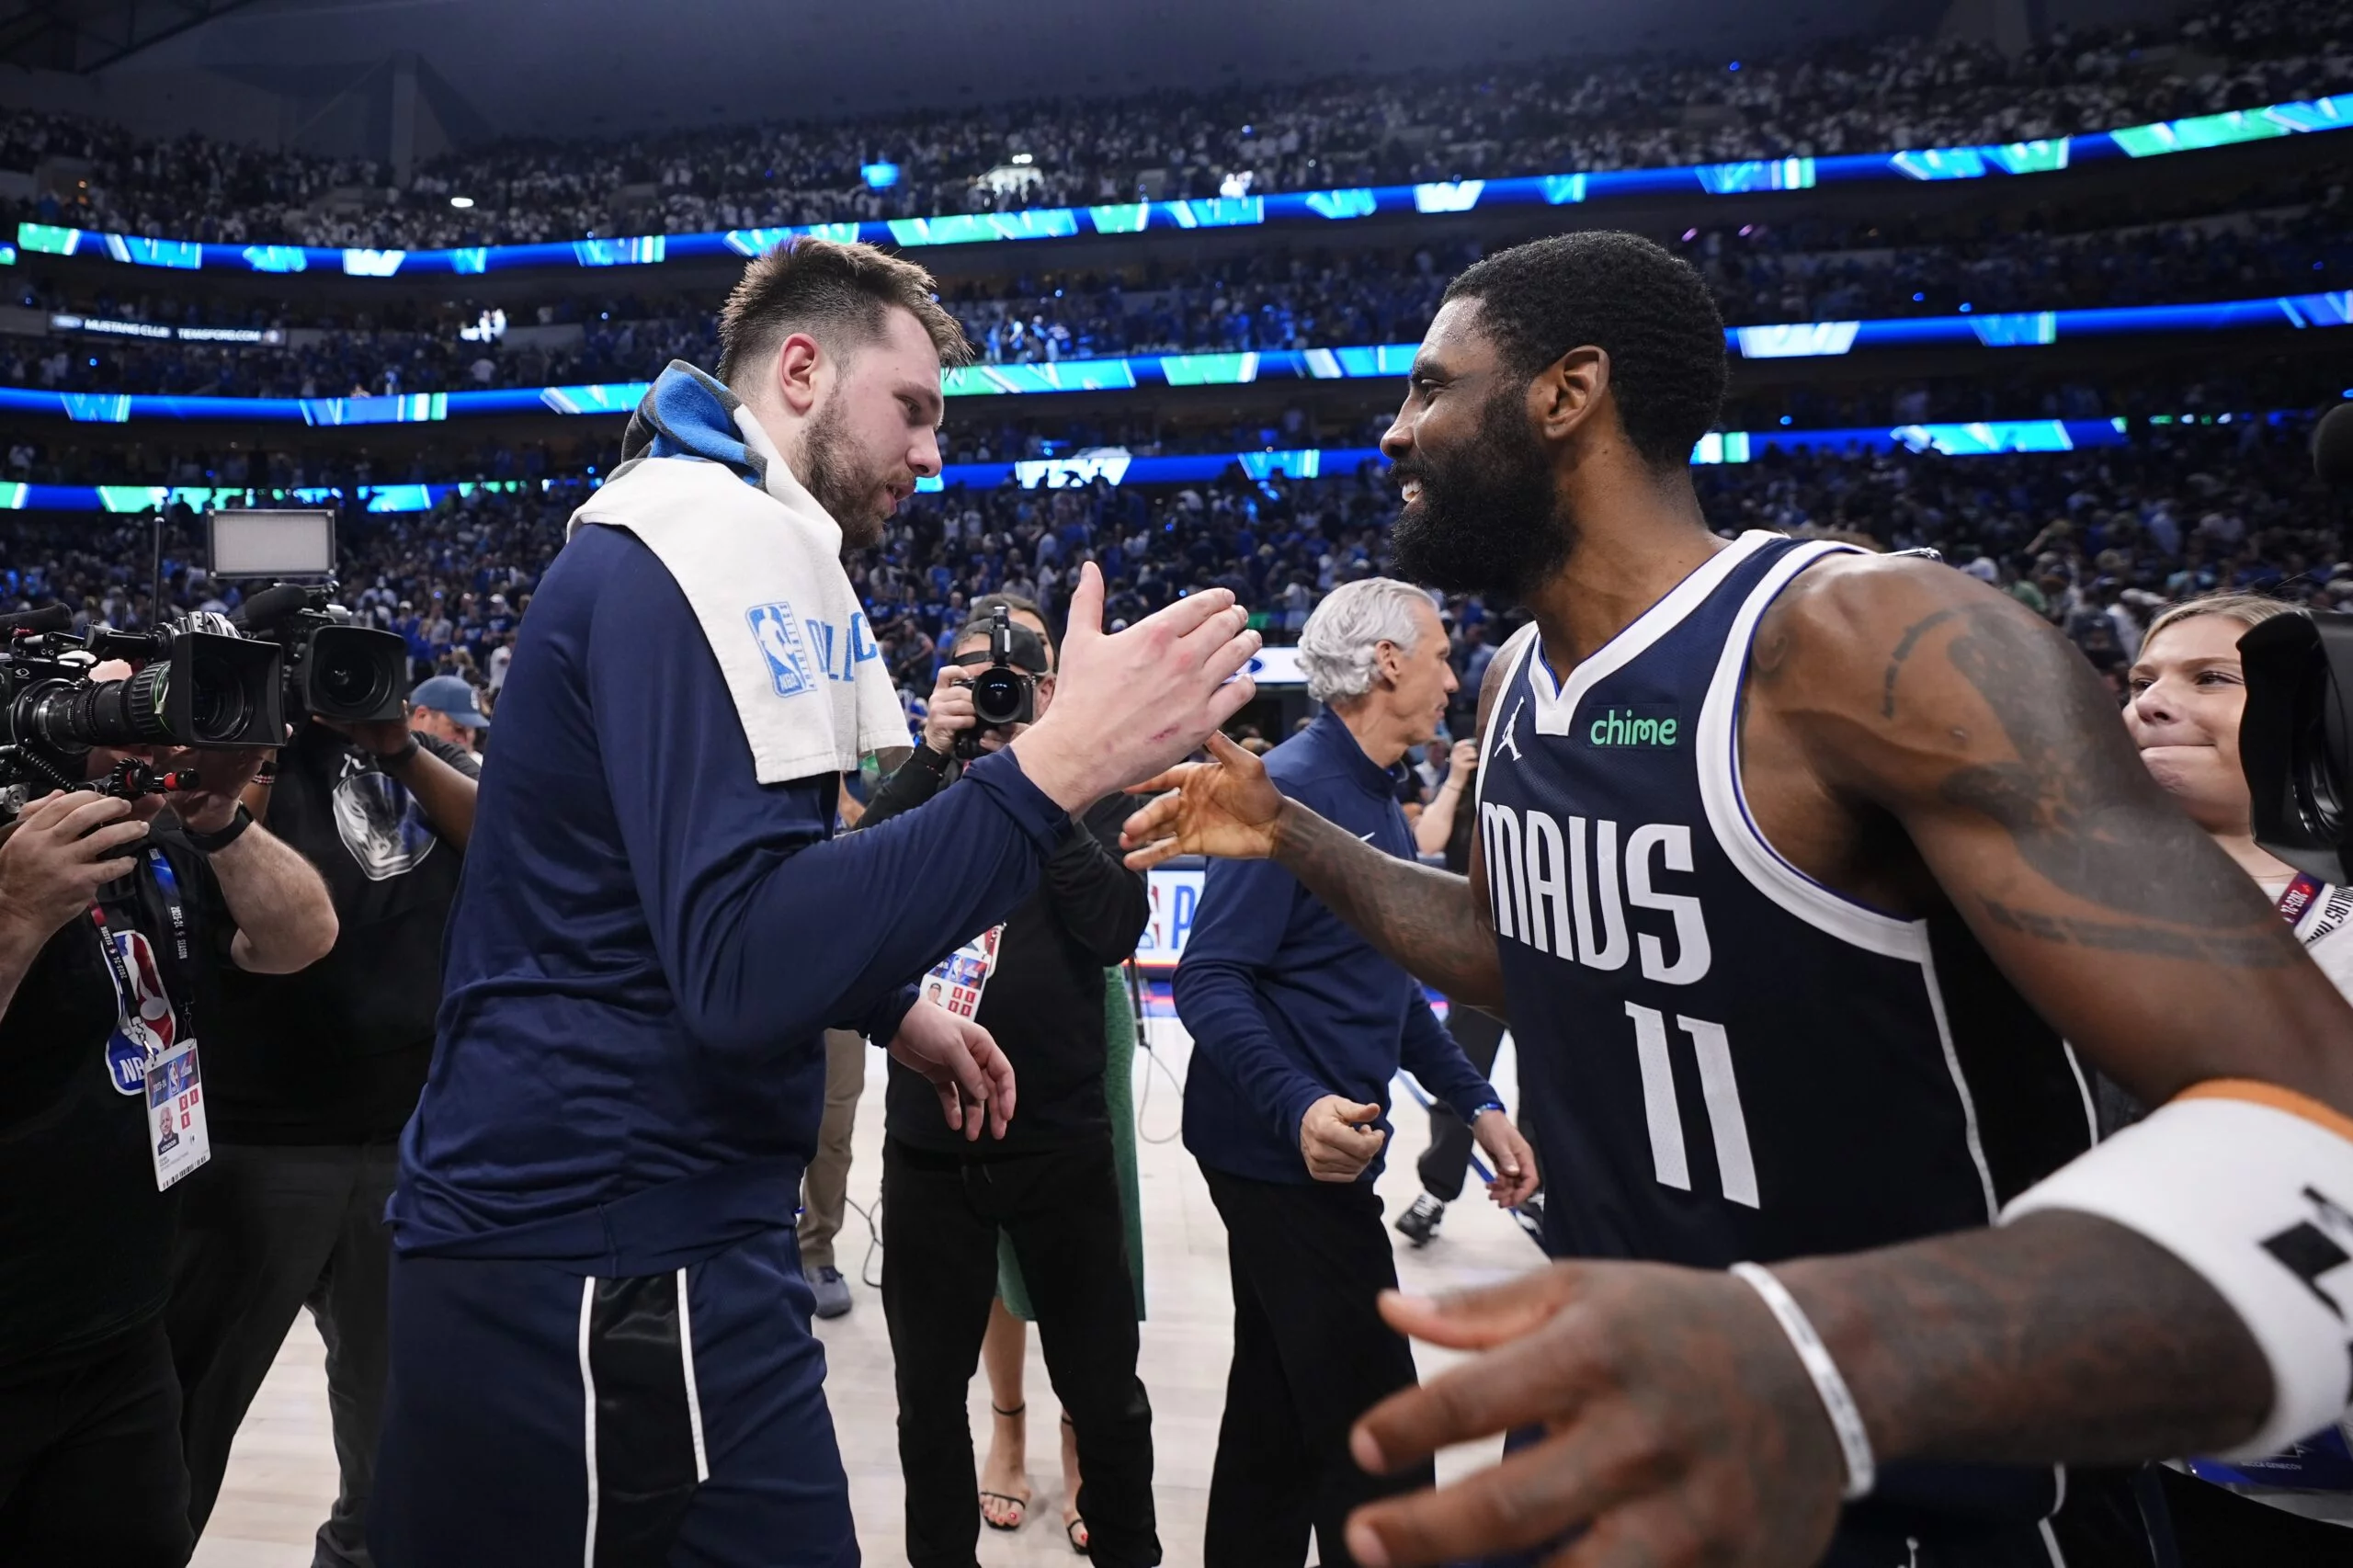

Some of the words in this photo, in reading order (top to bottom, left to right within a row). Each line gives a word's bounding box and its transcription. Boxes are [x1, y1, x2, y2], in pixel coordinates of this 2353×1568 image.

[1590, 710, 1677, 745] chime
[1483, 801, 1711, 985] MAVS
[119, 1057, 144, 1084] NB
[1625, 1000, 1760, 1209] 11
